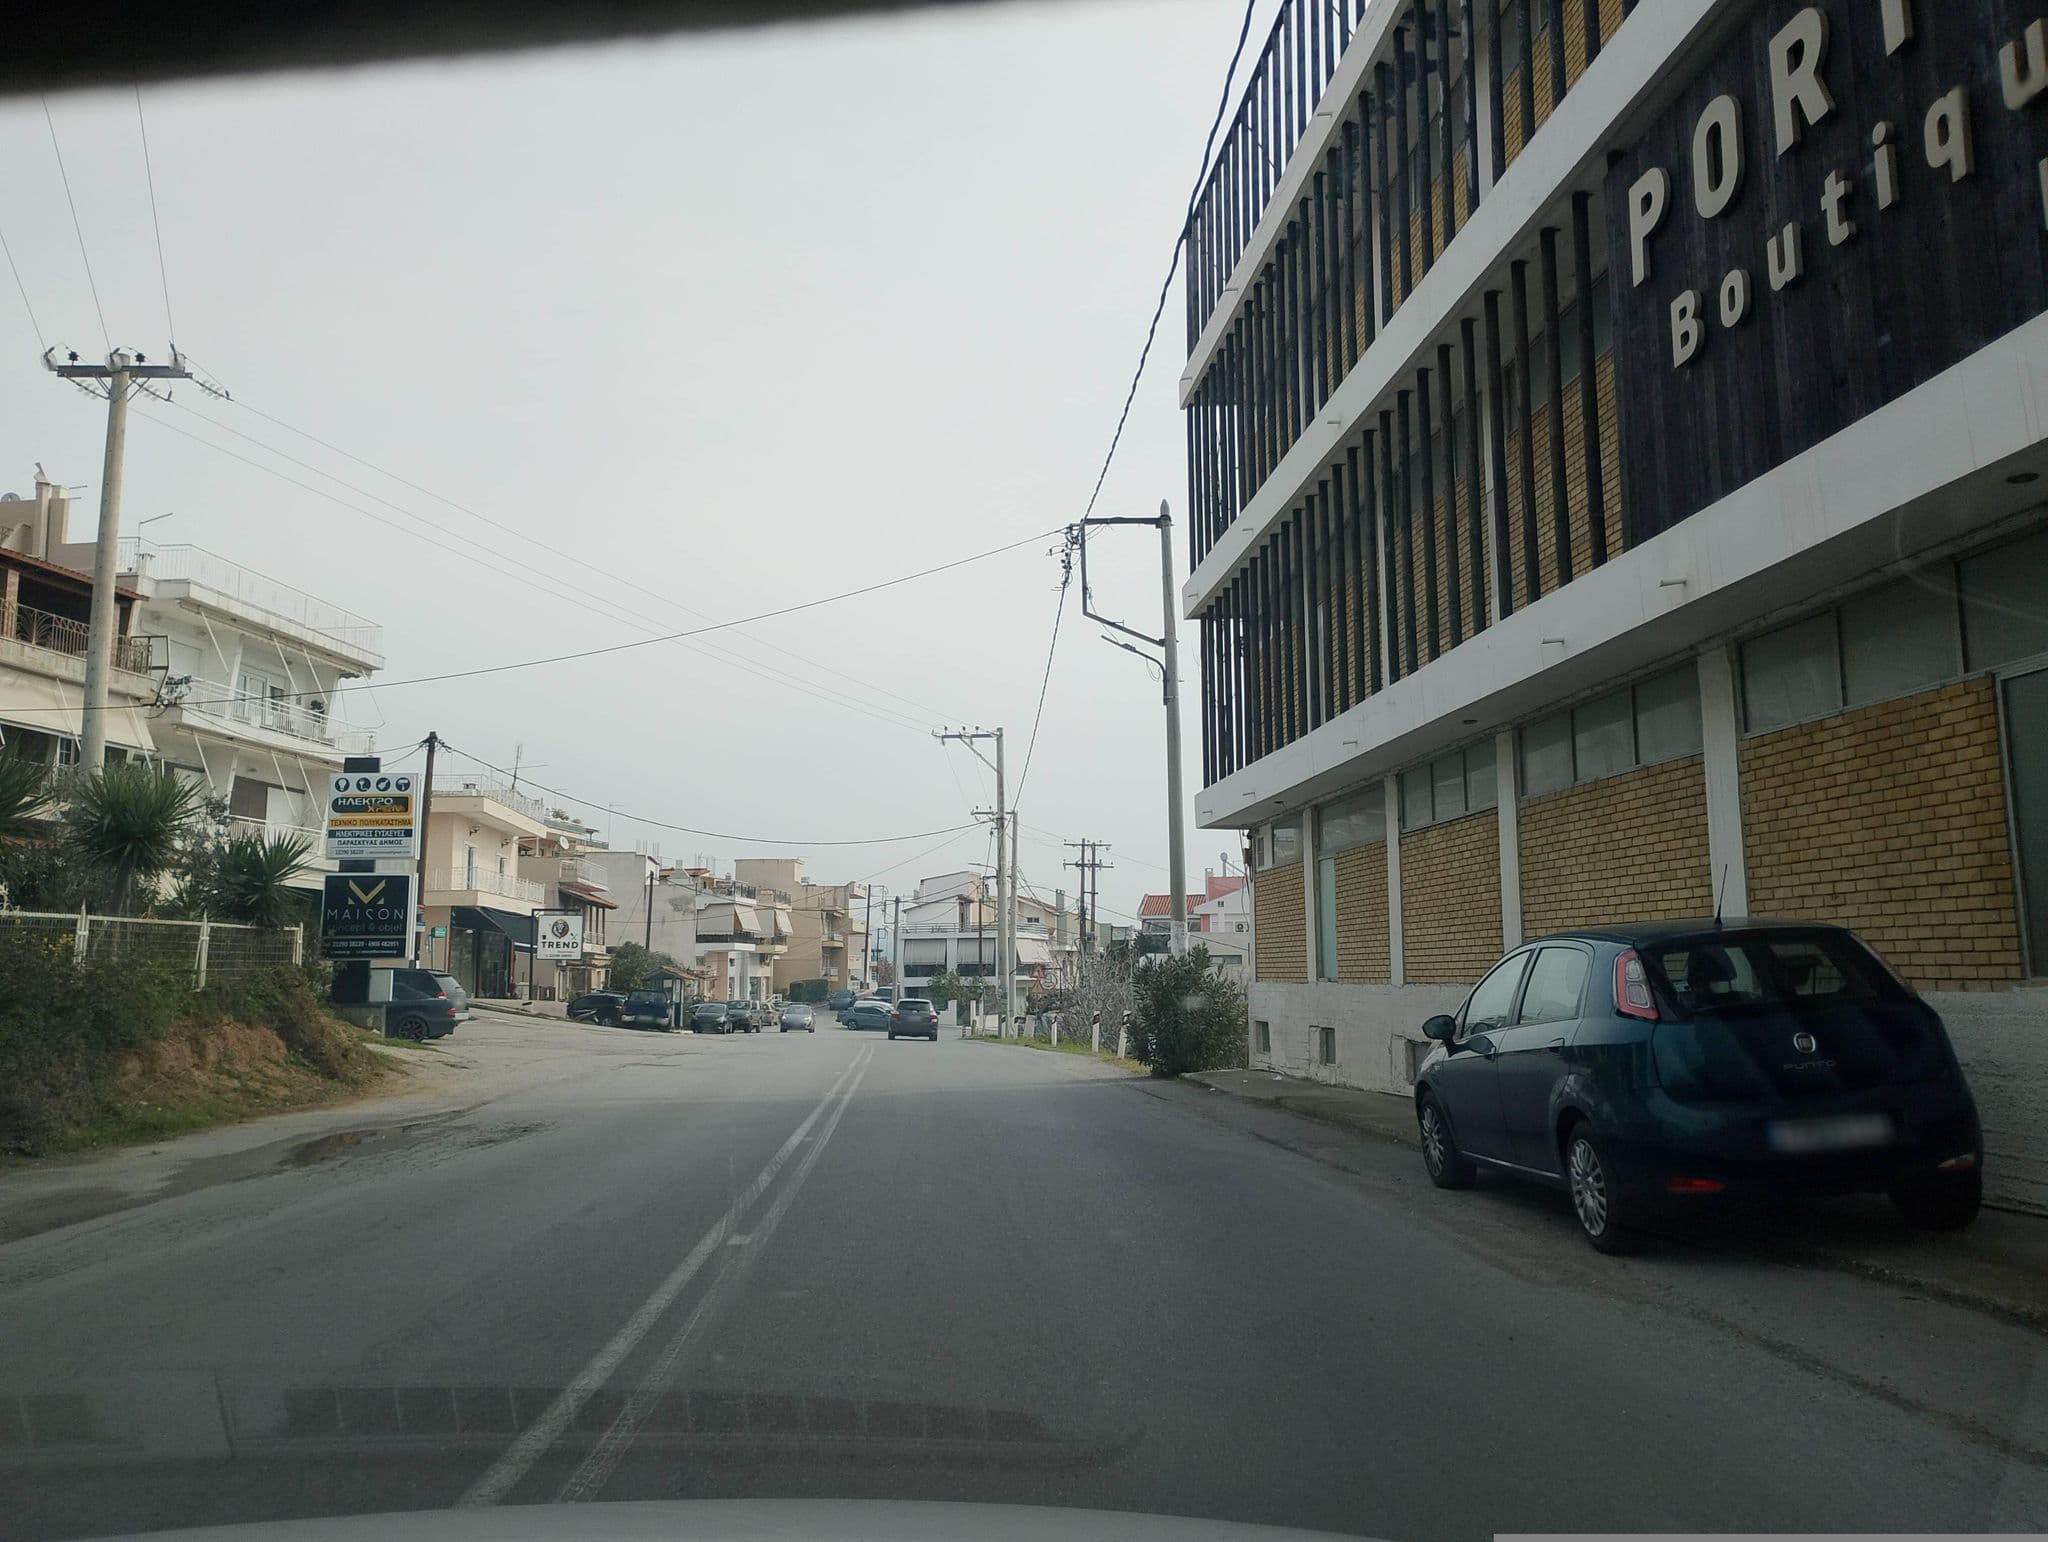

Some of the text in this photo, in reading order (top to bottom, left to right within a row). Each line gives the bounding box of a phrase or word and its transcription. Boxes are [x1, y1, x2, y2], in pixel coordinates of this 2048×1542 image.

[338, 797, 393, 806] ΗΛΕΚΤΡΟ
[330, 818, 411, 827] ΤΕΧΝΙΚΟ ΠΟΛΥΚΑΤΑΣΤΗΜΑ
[327, 908, 404, 920] MAISON
[541, 941, 579, 949] TREND
